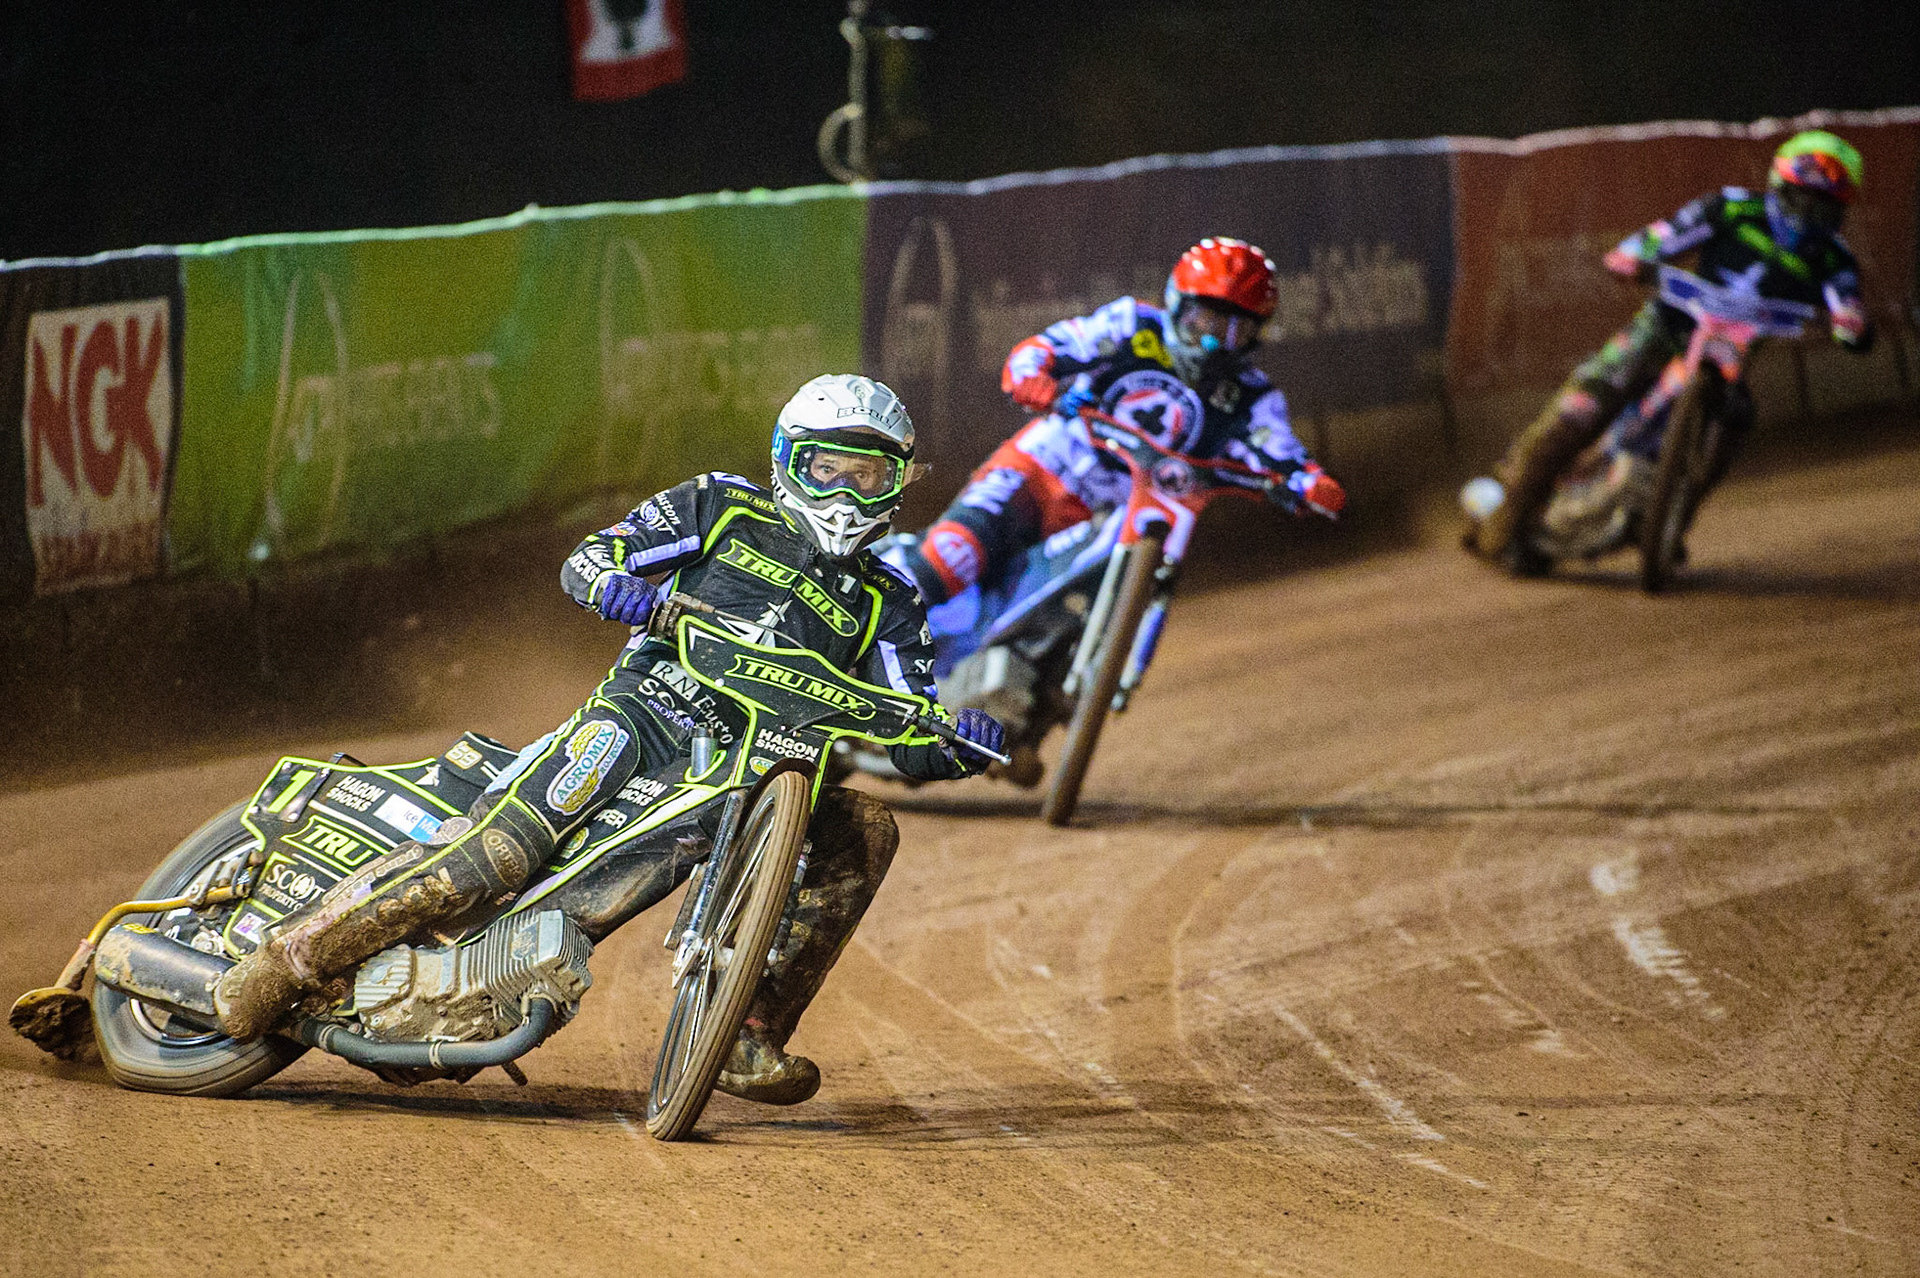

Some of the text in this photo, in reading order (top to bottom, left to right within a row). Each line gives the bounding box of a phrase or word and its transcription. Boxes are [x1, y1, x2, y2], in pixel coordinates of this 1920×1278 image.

[29, 311, 165, 508] NGK
[730, 489, 777, 512] TRU MIX
[736, 549, 850, 629] TRU MIX
[655, 664, 698, 698] R.N.
[744, 661, 866, 714] TRU MIX
[647, 699, 694, 730] PROPERT
[758, 728, 819, 758] HAGON
[557, 729, 613, 801] AGROMIX
[267, 769, 317, 813] 1
[326, 787, 372, 812] SHOCKS
[336, 775, 386, 802] HAGON
[402, 810, 418, 824] Ice
[302, 824, 373, 866] TRU
[258, 883, 297, 909] PROPERTY
[266, 863, 326, 904] SCOT
